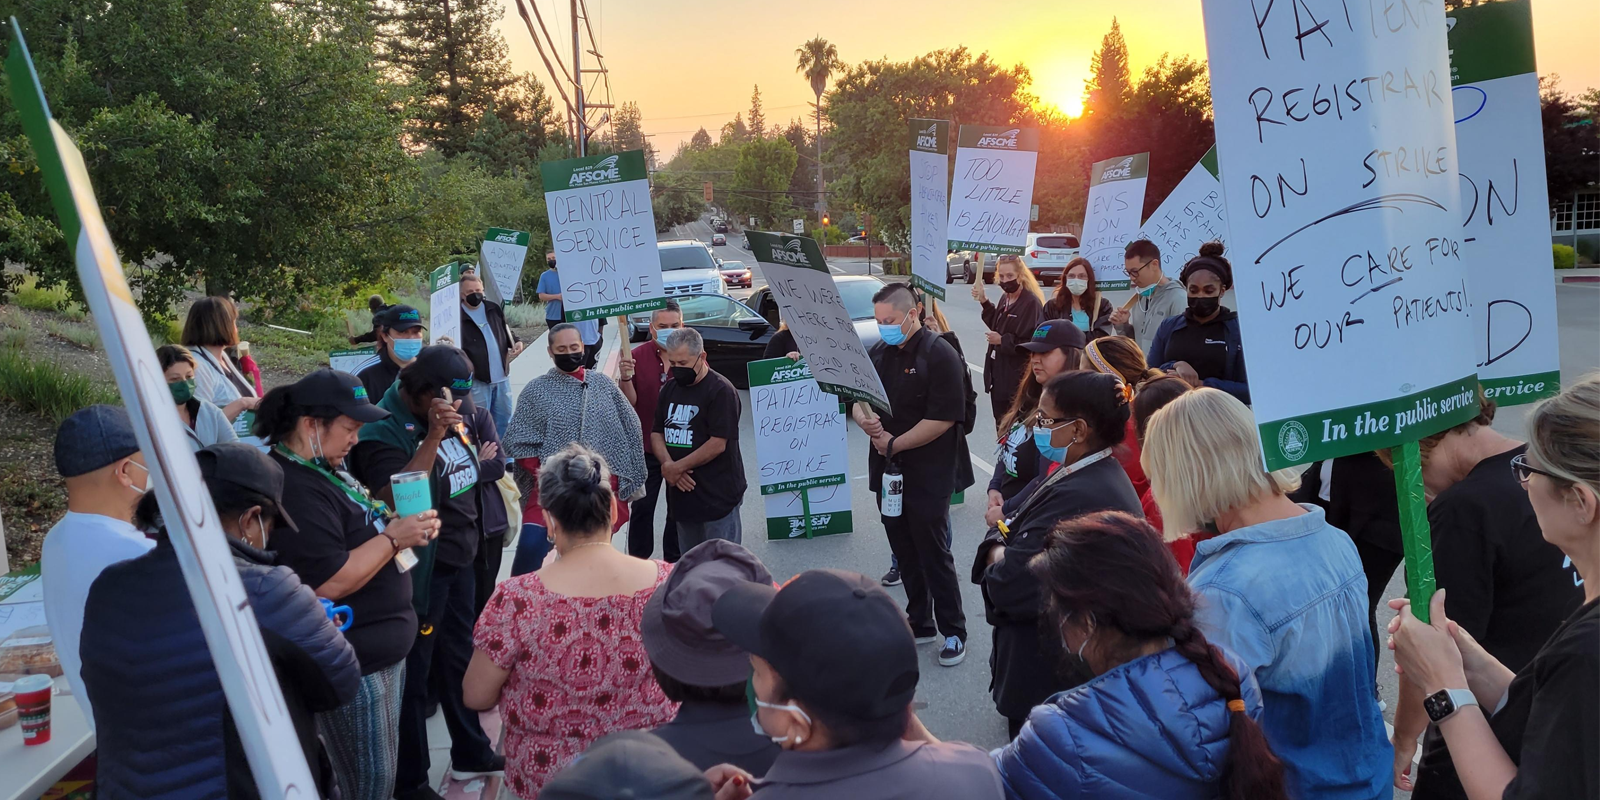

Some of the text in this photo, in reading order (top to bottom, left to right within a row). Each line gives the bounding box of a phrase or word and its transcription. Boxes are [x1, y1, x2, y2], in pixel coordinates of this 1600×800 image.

[1248, 70, 1443, 143] REGISTRAR
[977, 137, 1018, 147] AFSCME
[569, 168, 619, 184] AFSCME
[963, 157, 1003, 180] TOO
[1100, 167, 1132, 180] AFSCME
[964, 184, 1023, 204] LITTLE
[1250, 147, 1447, 218] ON STRIKE
[554, 189, 648, 225] CENTRAL
[1093, 191, 1129, 215] EVS
[1201, 190, 1224, 221] BIL
[954, 210, 1029, 238] IS ENOUGH
[1097, 218, 1121, 233] ON
[1163, 210, 1190, 240] HAS
[556, 227, 645, 253] SERVICE
[980, 243, 1000, 251] public
[1085, 233, 1129, 255] STRIKE
[1154, 224, 1180, 253] TAKE
[590, 253, 616, 275] ON
[772, 248, 810, 264] AFSCME
[1100, 264, 1126, 272] PATIENT
[1261, 237, 1461, 312] WE CARE FOR
[566, 276, 652, 304] STRIKE
[770, 276, 846, 310] WE WERE
[586, 309, 595, 317] In
[610, 304, 634, 314] public
[635, 300, 661, 309] service
[782, 304, 834, 330] THERE
[798, 330, 818, 348] YOU
[1294, 310, 1364, 349] OUR
[770, 366, 812, 381] AFSCME
[1483, 380, 1545, 399] ervice
[759, 410, 841, 437] REGISTRAR
[1321, 419, 1347, 444] In
[1354, 411, 1390, 438] the
[1395, 397, 1438, 434] public
[1440, 388, 1474, 418] service
[789, 434, 810, 450] ON
[760, 453, 831, 478] STRIKE
[778, 476, 841, 490] In the public service
[789, 516, 832, 528] AFSME
